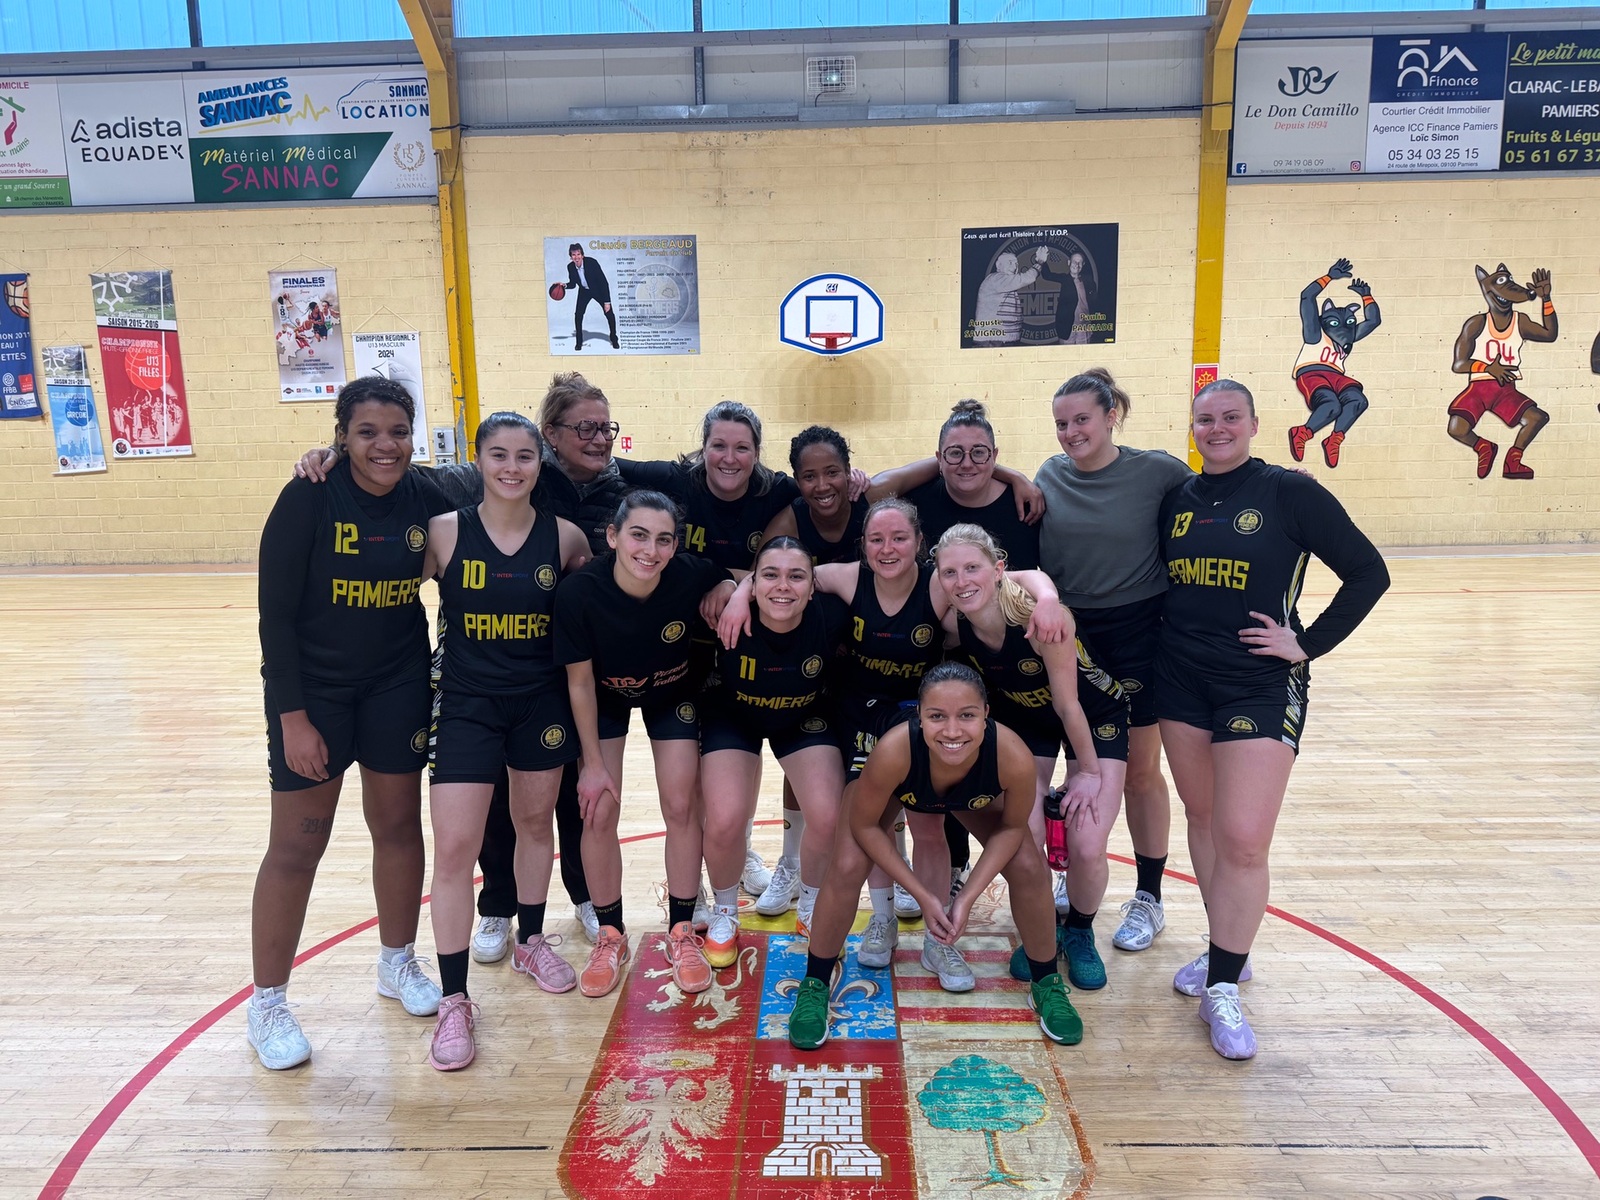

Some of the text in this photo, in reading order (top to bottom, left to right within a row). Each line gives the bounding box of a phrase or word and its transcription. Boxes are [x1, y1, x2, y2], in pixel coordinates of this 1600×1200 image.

[1510, 42, 1534, 64] Le
[1533, 42, 1579, 66] petit
[0, 82, 29, 90] MICILE
[1429, 75, 1479, 87] Finance
[1508, 80, 1562, 94] CLARAC
[1570, 80, 1587, 93] LE
[197, 77, 288, 104] AMBULANCES
[389, 84, 427, 97] SANNAC
[200, 91, 293, 127] SANNAC
[341, 104, 430, 119] LOCATION
[1245, 103, 1359, 118] Le Don Camillo
[1382, 105, 1491, 116] Courtier Crédit Immobilier
[1541, 104, 1600, 118] PAMIERS
[95, 116, 183, 139] adista
[1274, 122, 1305, 132] Depuis
[1373, 122, 1498, 134] Agence ICC Finance Pamiers
[1410, 133, 1459, 142] Loïc Simon
[1506, 130, 1547, 143] Fruits
[1550, 130, 1562, 143] &
[82, 145, 184, 163] EQUADEX
[200, 145, 357, 166] Matériel Médical
[1388, 148, 1479, 160] 05 34 03 25 15
[1505, 151, 1525, 163] 05
[1530, 150, 1550, 163] 61
[1557, 150, 1578, 162] 67
[222, 163, 339, 194] SANNAC
[13, 182, 33, 191] grand
[33, 182, 55, 190] Sourire
[589, 239, 693, 250] Claude BERGEAUD
[282, 276, 325, 285] FINALES
[1080, 312, 1107, 321] Paulin
[108, 318, 159, 329] SAISON 2015-2016
[968, 319, 1003, 328] Auguste
[1072, 323, 1114, 332] PALMADE
[964, 330, 1007, 338] SAVIGNOL
[378, 350, 394, 358] 2024
[1320, 346, 1339, 364] 01
[1485, 339, 1515, 364] 04
[147, 356, 159, 367] U13
[139, 367, 160, 378] FILLES
[1171, 512, 1194, 539] 13
[334, 522, 359, 554] 12
[685, 524, 706, 553] 14
[462, 559, 486, 590] 10
[1168, 558, 1250, 590] PAMIERS
[332, 577, 421, 608] PAMIERS
[740, 655, 757, 681] 11
[736, 690, 817, 710] PAMIERS
